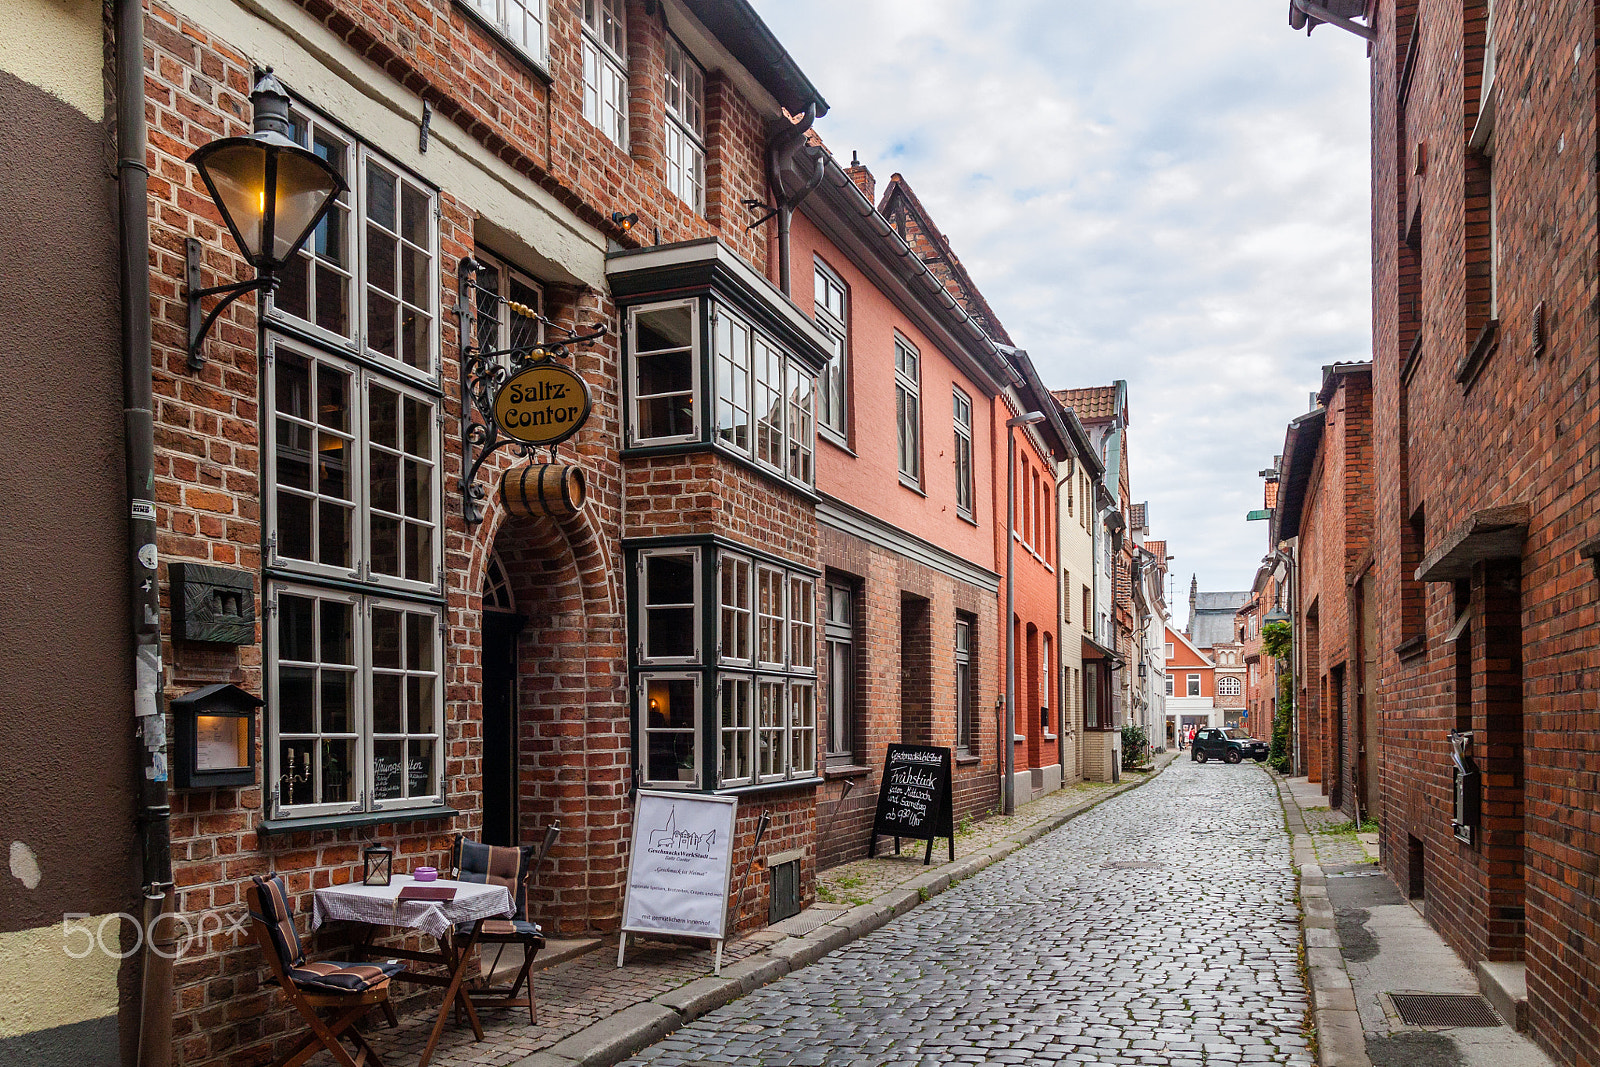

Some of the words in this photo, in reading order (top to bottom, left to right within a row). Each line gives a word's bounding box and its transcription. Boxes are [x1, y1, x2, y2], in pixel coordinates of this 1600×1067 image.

[510, 381, 570, 404] Saltz-
[504, 405, 578, 428] Contor
[890, 766, 938, 789] Frühstück
[885, 807, 896, 820] ab
[909, 812, 923, 827] Uhr
[887, 795, 899, 804] und
[900, 796, 926, 816] Samstag
